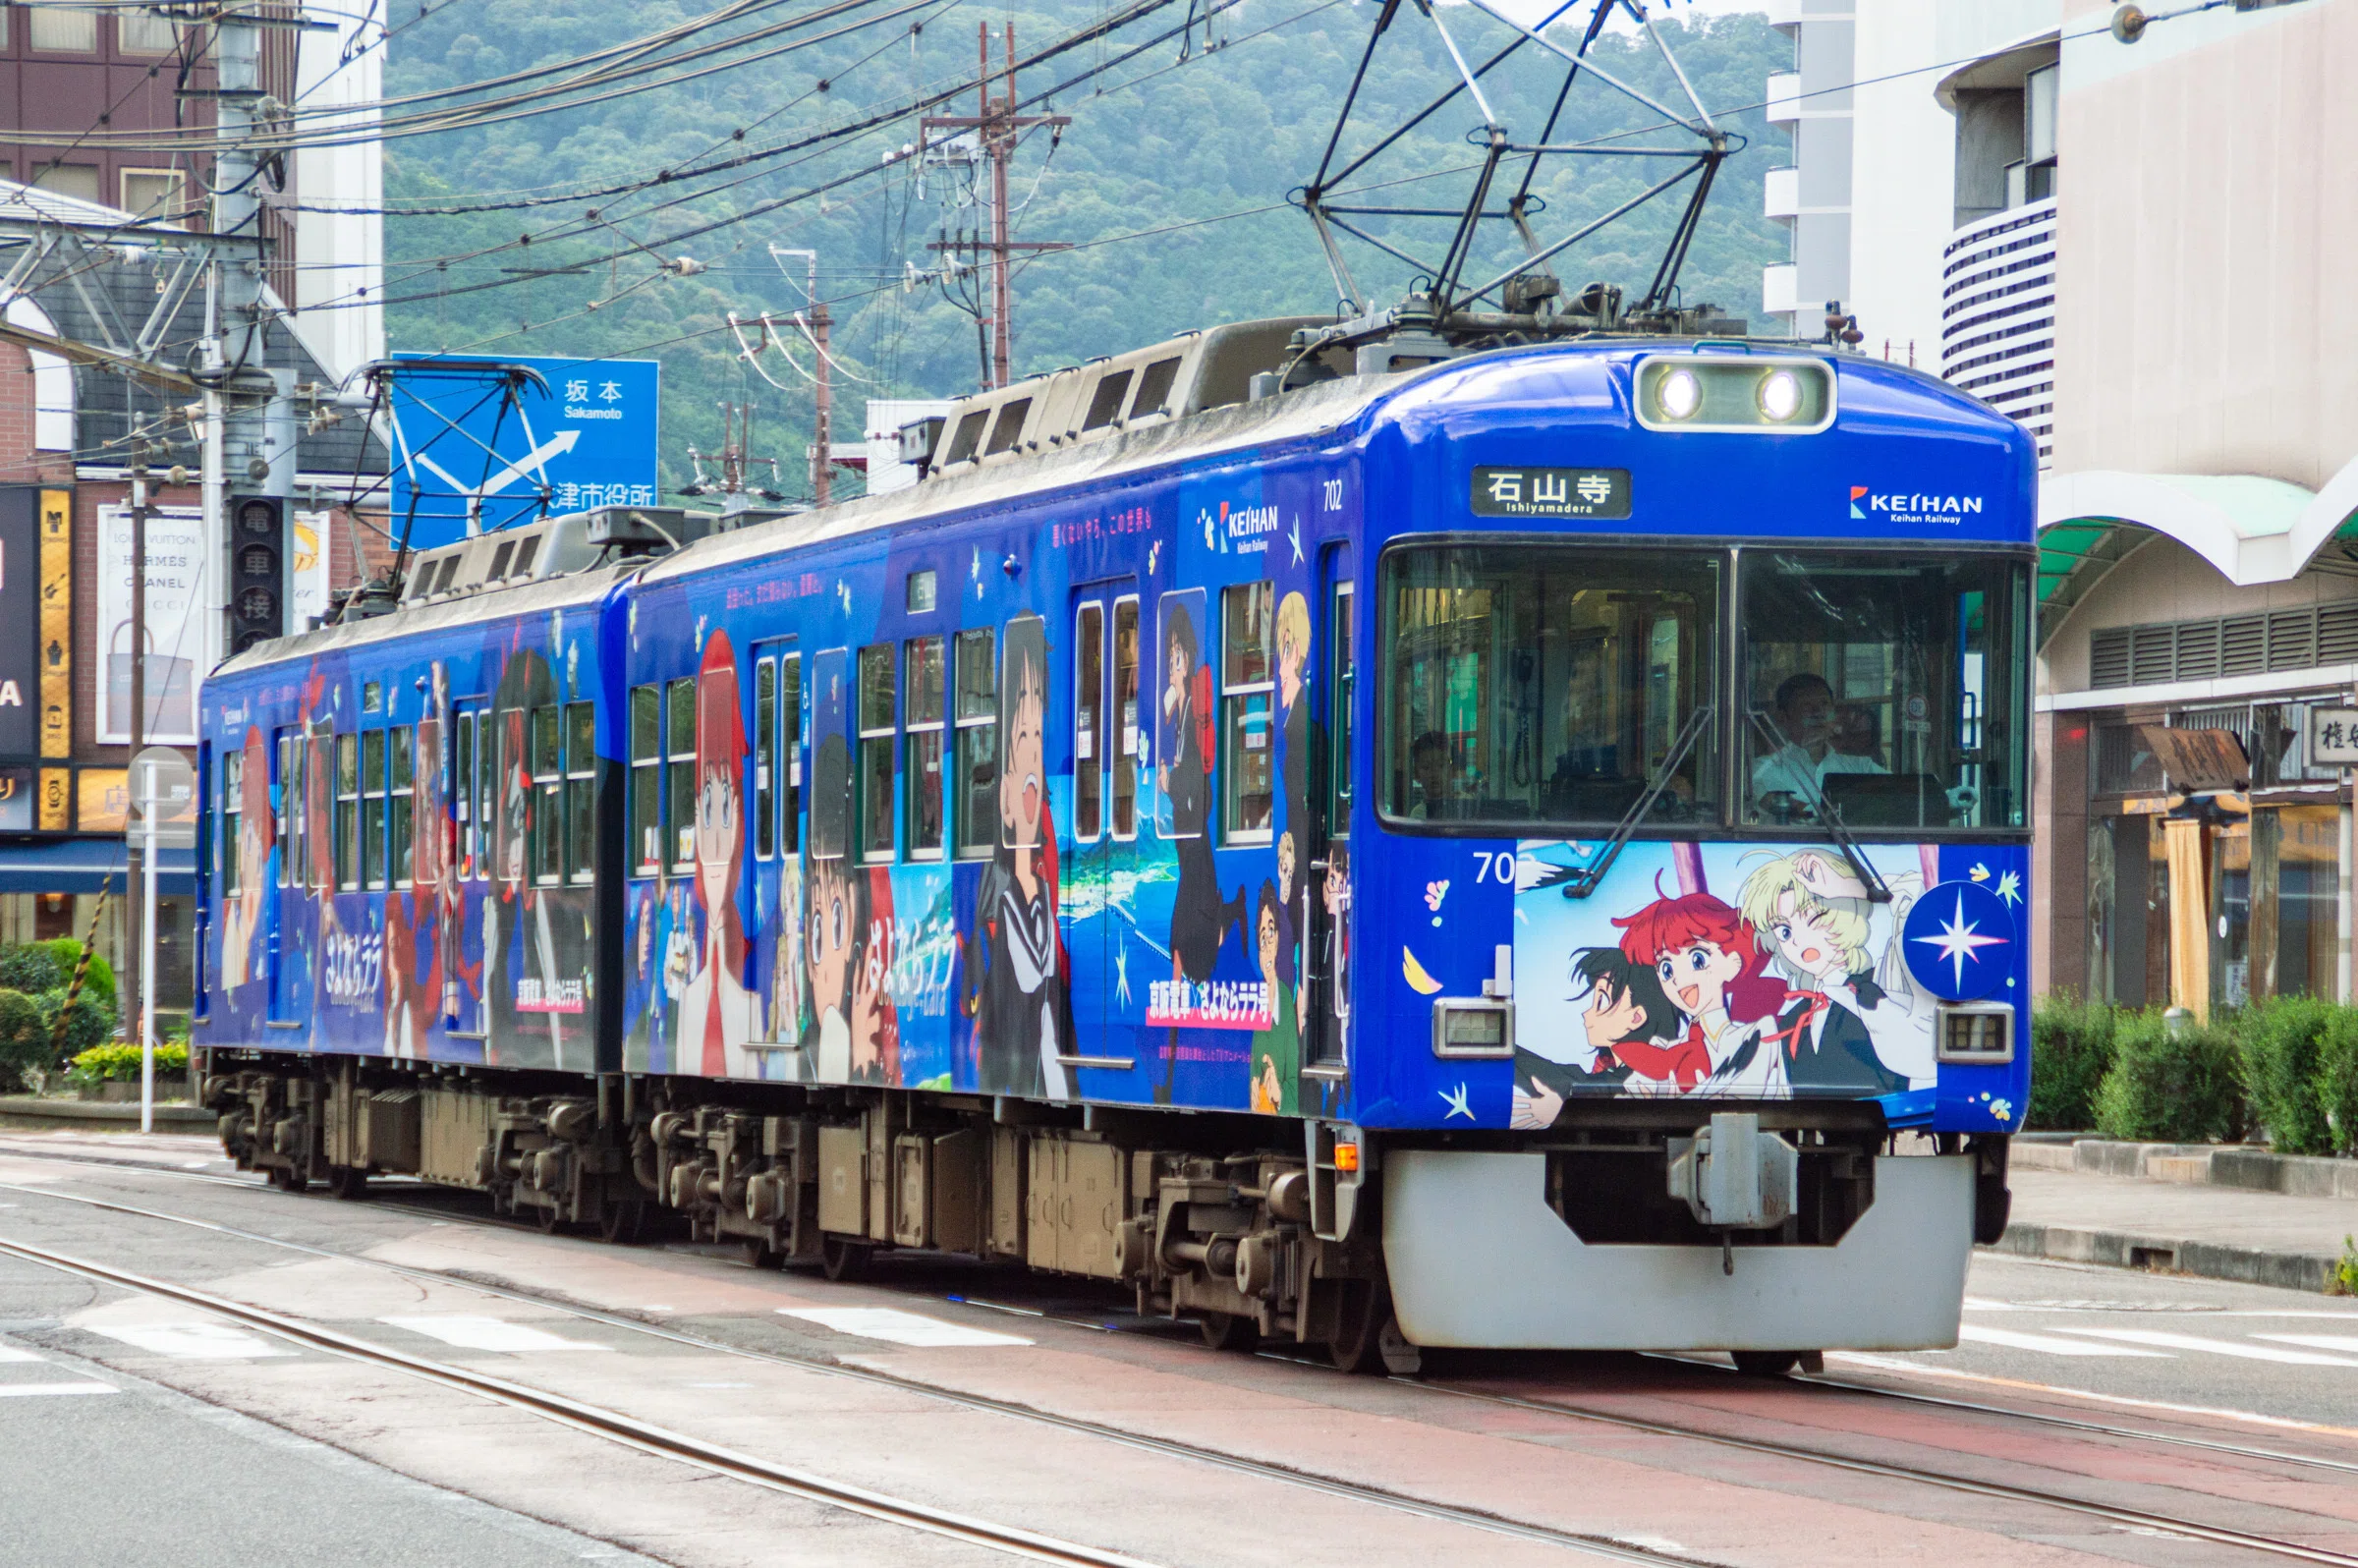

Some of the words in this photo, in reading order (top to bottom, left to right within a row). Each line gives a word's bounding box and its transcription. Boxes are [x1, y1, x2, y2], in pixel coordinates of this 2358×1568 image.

[565, 379, 623, 404] 坂本
[564, 406, 623, 420] Sakamoto
[1322, 478, 1343, 513] 702
[1488, 473, 1611, 504] 石山寺
[1506, 502, 1594, 515] Ishiyamadera
[1870, 493, 1983, 514] KEIHAN
[1228, 505, 1278, 538] KEIHAN
[1890, 514, 1923, 523] Keihan
[1925, 514, 1961, 526] Railway
[147, 534, 196, 545] VUITTON
[124, 577, 186, 588] CANEL
